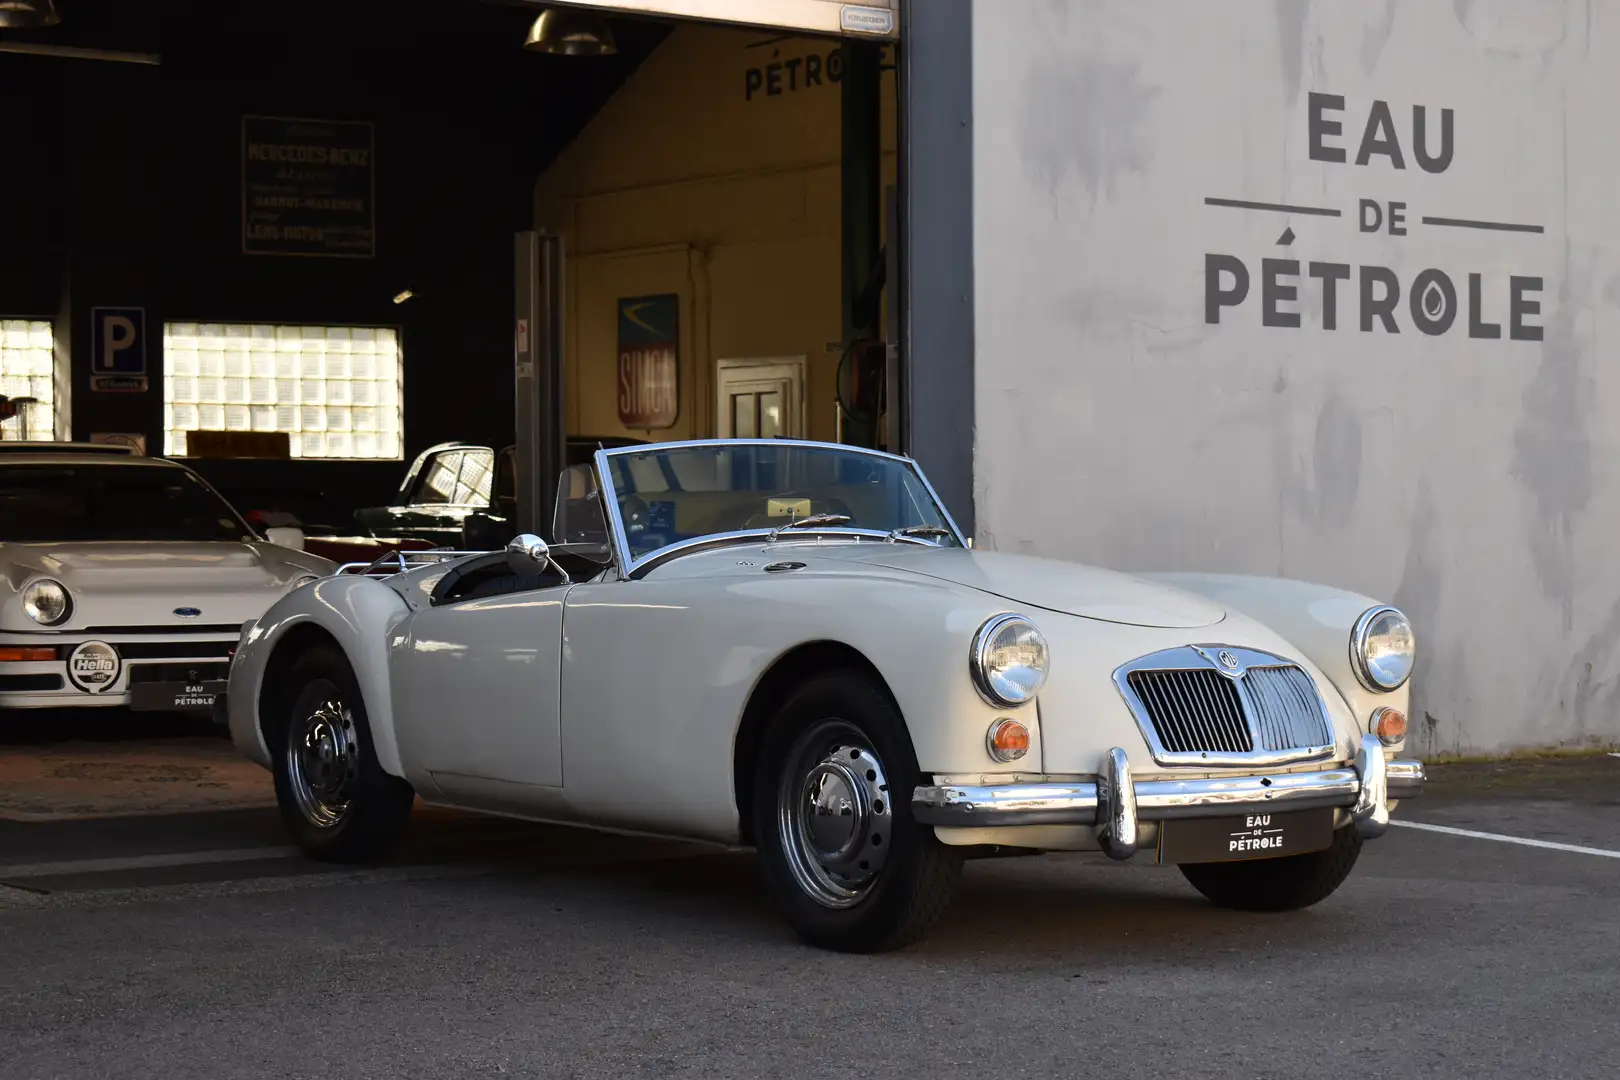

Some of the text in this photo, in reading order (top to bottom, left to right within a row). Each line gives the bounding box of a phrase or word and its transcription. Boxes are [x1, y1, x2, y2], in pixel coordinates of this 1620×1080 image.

[1308, 91, 1454, 174] EAU
[1359, 198, 1407, 236] DE
[1205, 227, 1544, 341] PÉTROLE
[103, 316, 136, 368] P
[620, 348, 674, 416] SIMCA
[77, 660, 113, 670] Hella
[174, 696, 214, 706] PÉTROLE
[185, 685, 204, 693] EAU
[1246, 815, 1271, 827] EAU
[1229, 836, 1283, 851] PÉTROLE
